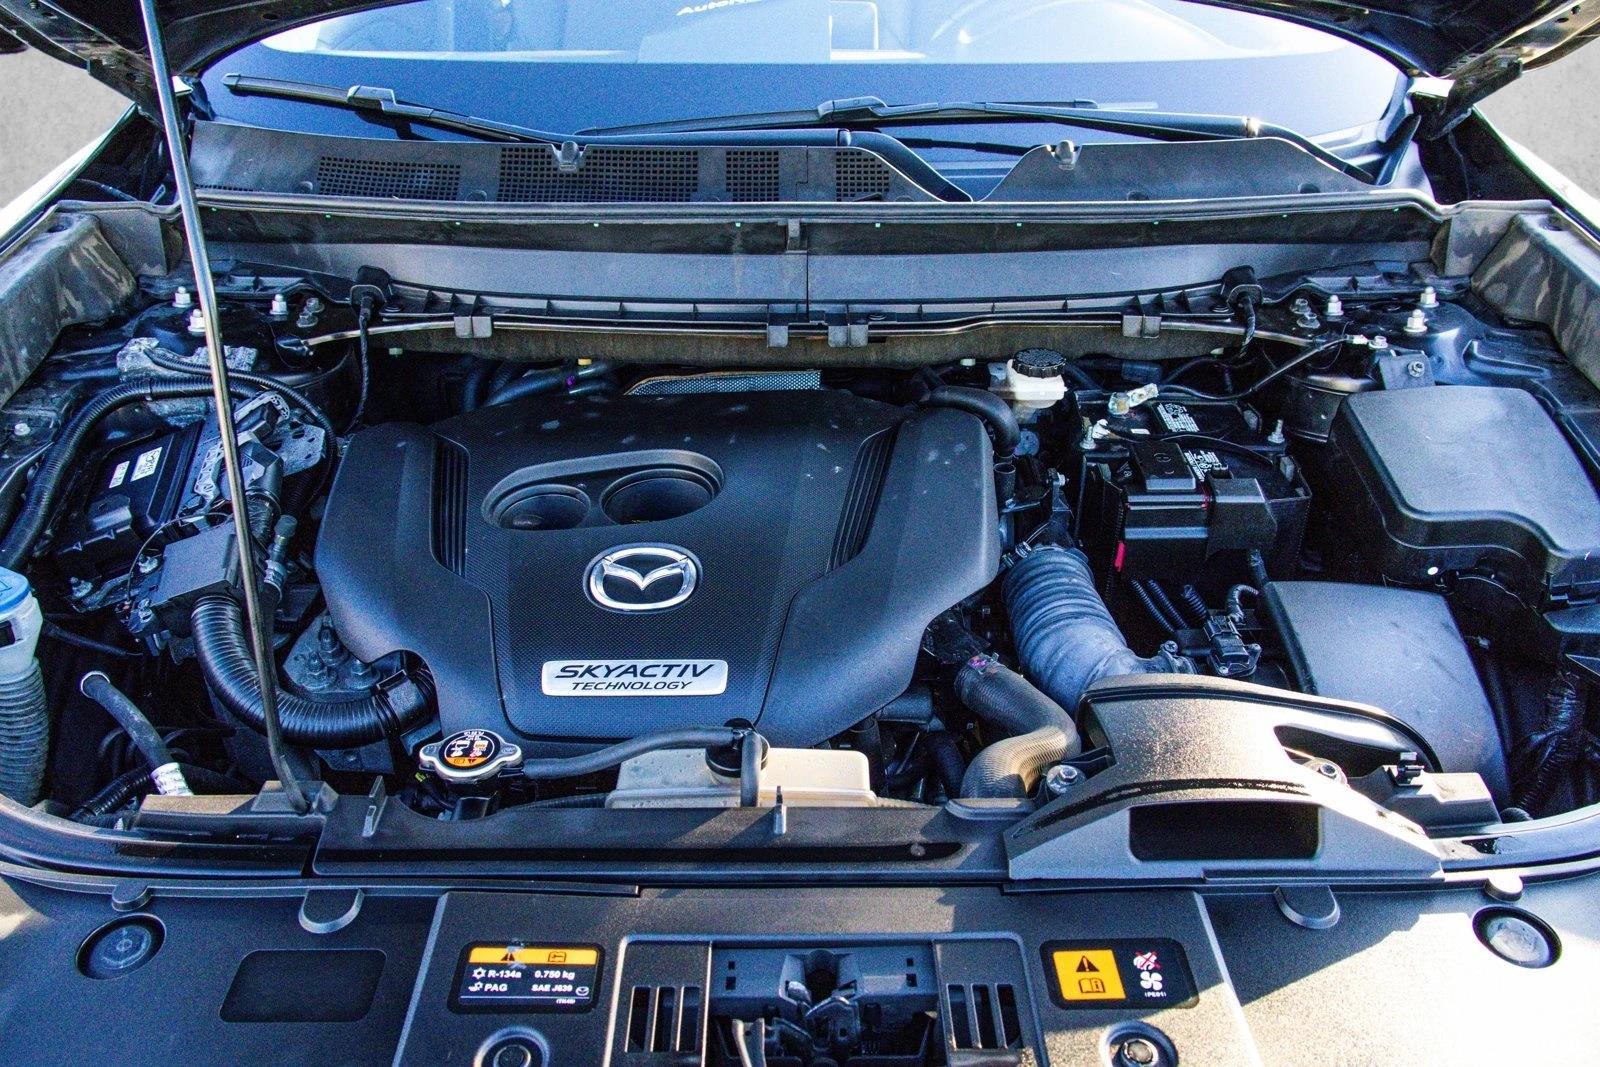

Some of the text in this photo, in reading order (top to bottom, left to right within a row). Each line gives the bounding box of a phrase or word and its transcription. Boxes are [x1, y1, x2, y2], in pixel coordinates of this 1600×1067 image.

[554, 663, 715, 679] SKYACTIV
[572, 681, 693, 691] TECHNOLOGY
[487, 970, 575, 980] R-134a 0.750 kg
[484, 983, 508, 992] PAG
[531, 984, 551, 992] SAE
